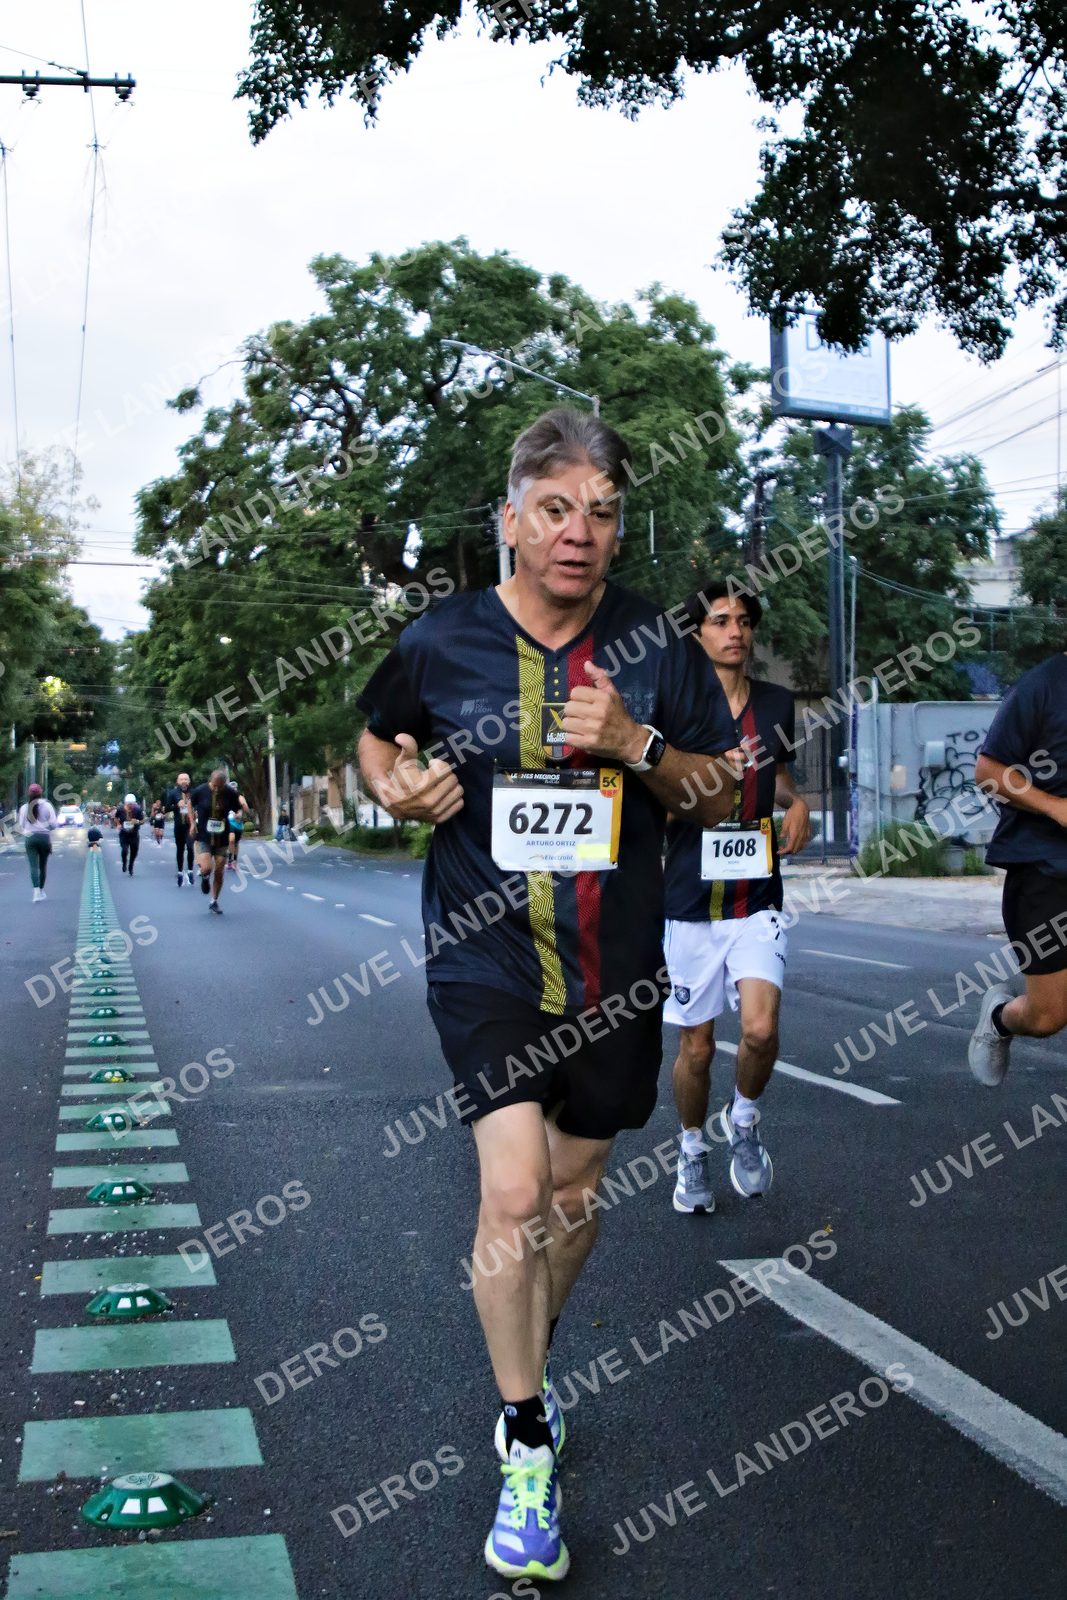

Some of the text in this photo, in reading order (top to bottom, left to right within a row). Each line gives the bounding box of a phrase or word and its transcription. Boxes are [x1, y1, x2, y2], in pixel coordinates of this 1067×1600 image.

[602, 776, 617, 788] 5K
[508, 802, 593, 834] 6272
[712, 838, 757, 858] 1608
